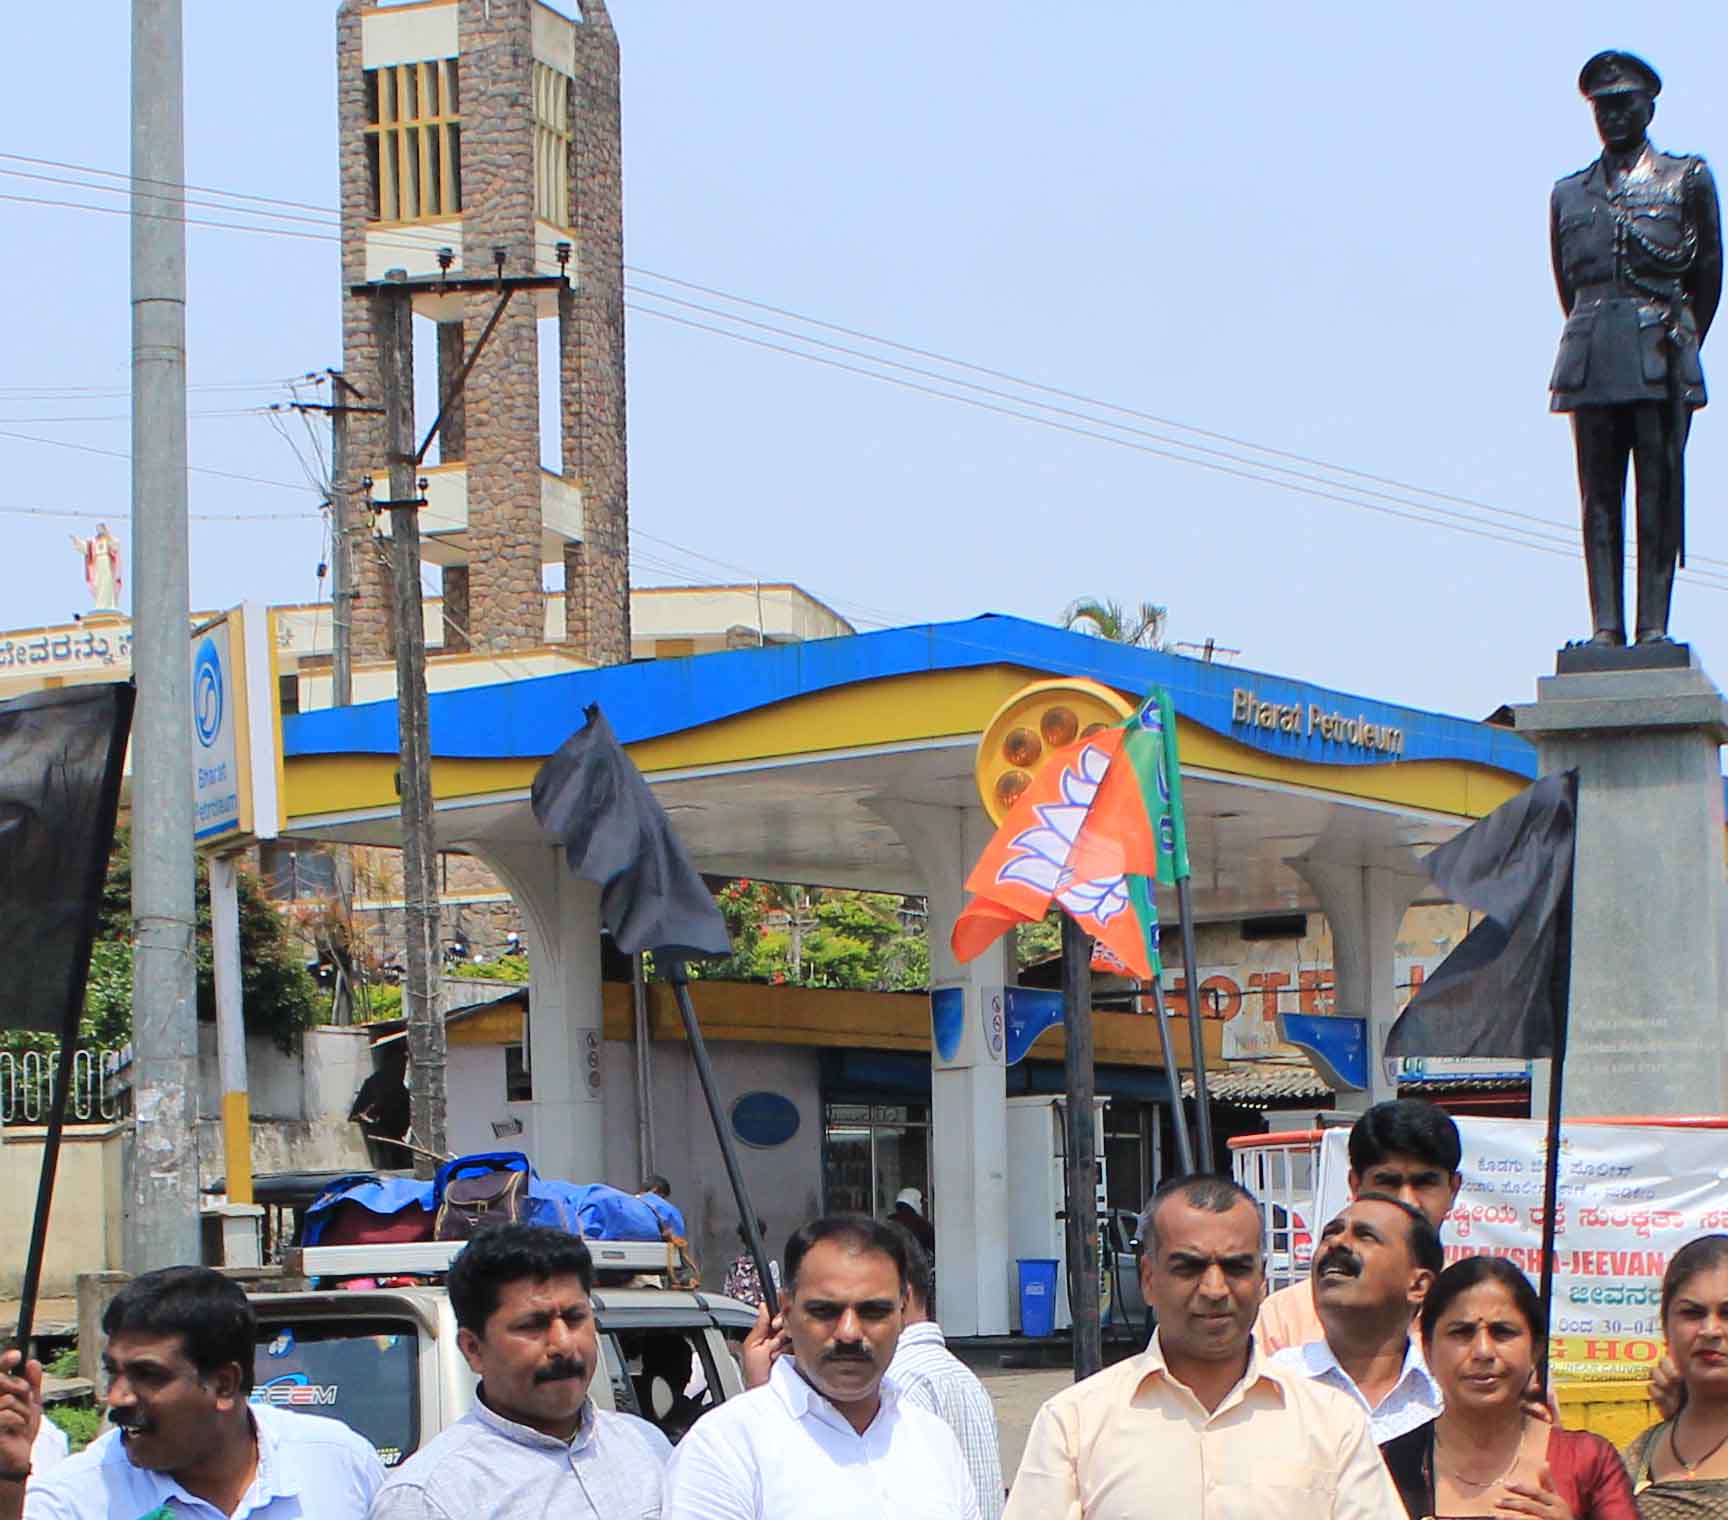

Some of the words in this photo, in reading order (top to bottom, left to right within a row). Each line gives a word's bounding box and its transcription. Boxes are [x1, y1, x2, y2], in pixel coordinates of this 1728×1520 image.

[1232, 687, 1302, 733] Bharat
[1307, 703, 1405, 755] Petroleum
[1139, 970, 1336, 1022] HOTE
